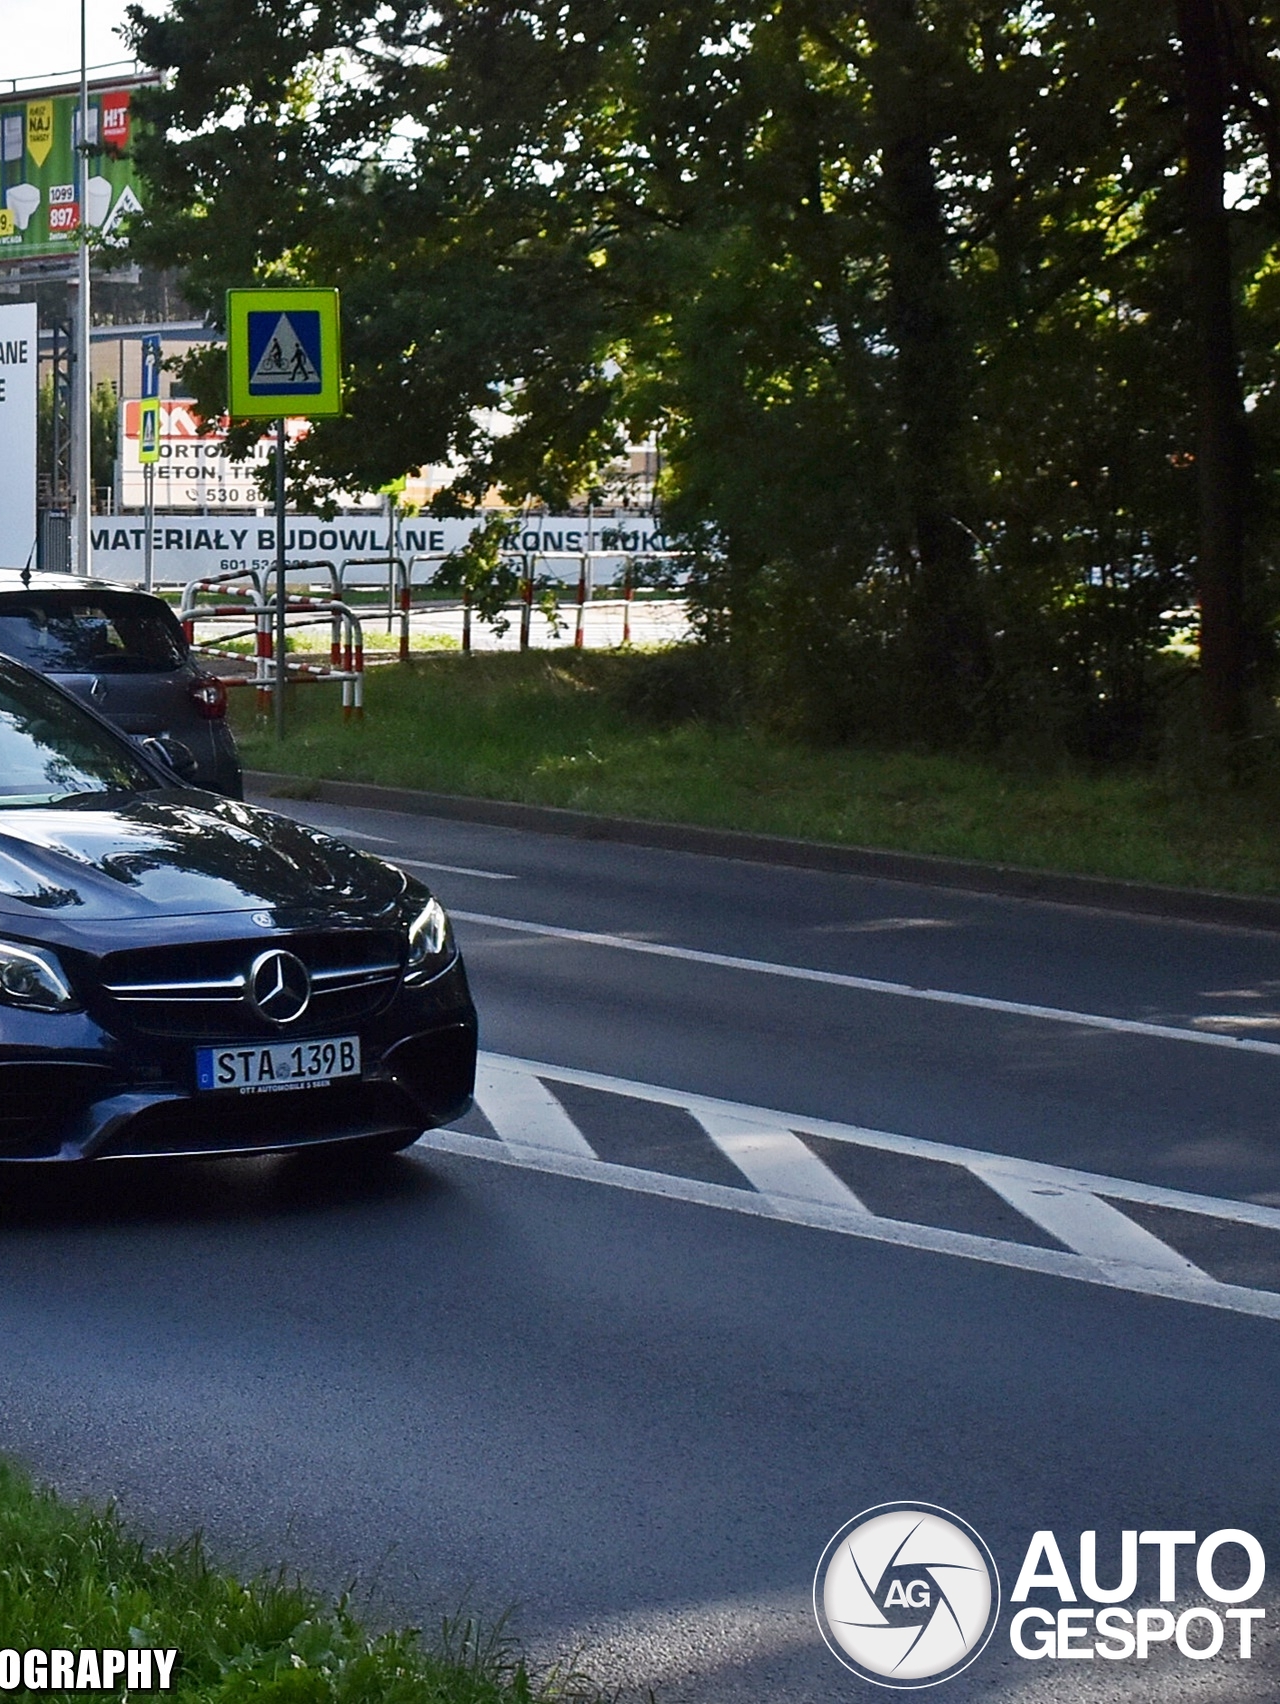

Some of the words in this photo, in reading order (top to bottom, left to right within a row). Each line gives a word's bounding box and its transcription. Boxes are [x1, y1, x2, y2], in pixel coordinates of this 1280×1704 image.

[29, 117, 51, 134] NAJ
[50, 190, 73, 202] 1099
[206, 488, 239, 501] 530
[91, 528, 247, 551] MATERIAŁY
[258, 528, 444, 551] BUDOWLANE
[221, 560, 246, 570] 601
[218, 1049, 275, 1084] STA
[291, 1041, 355, 1077] 139B
